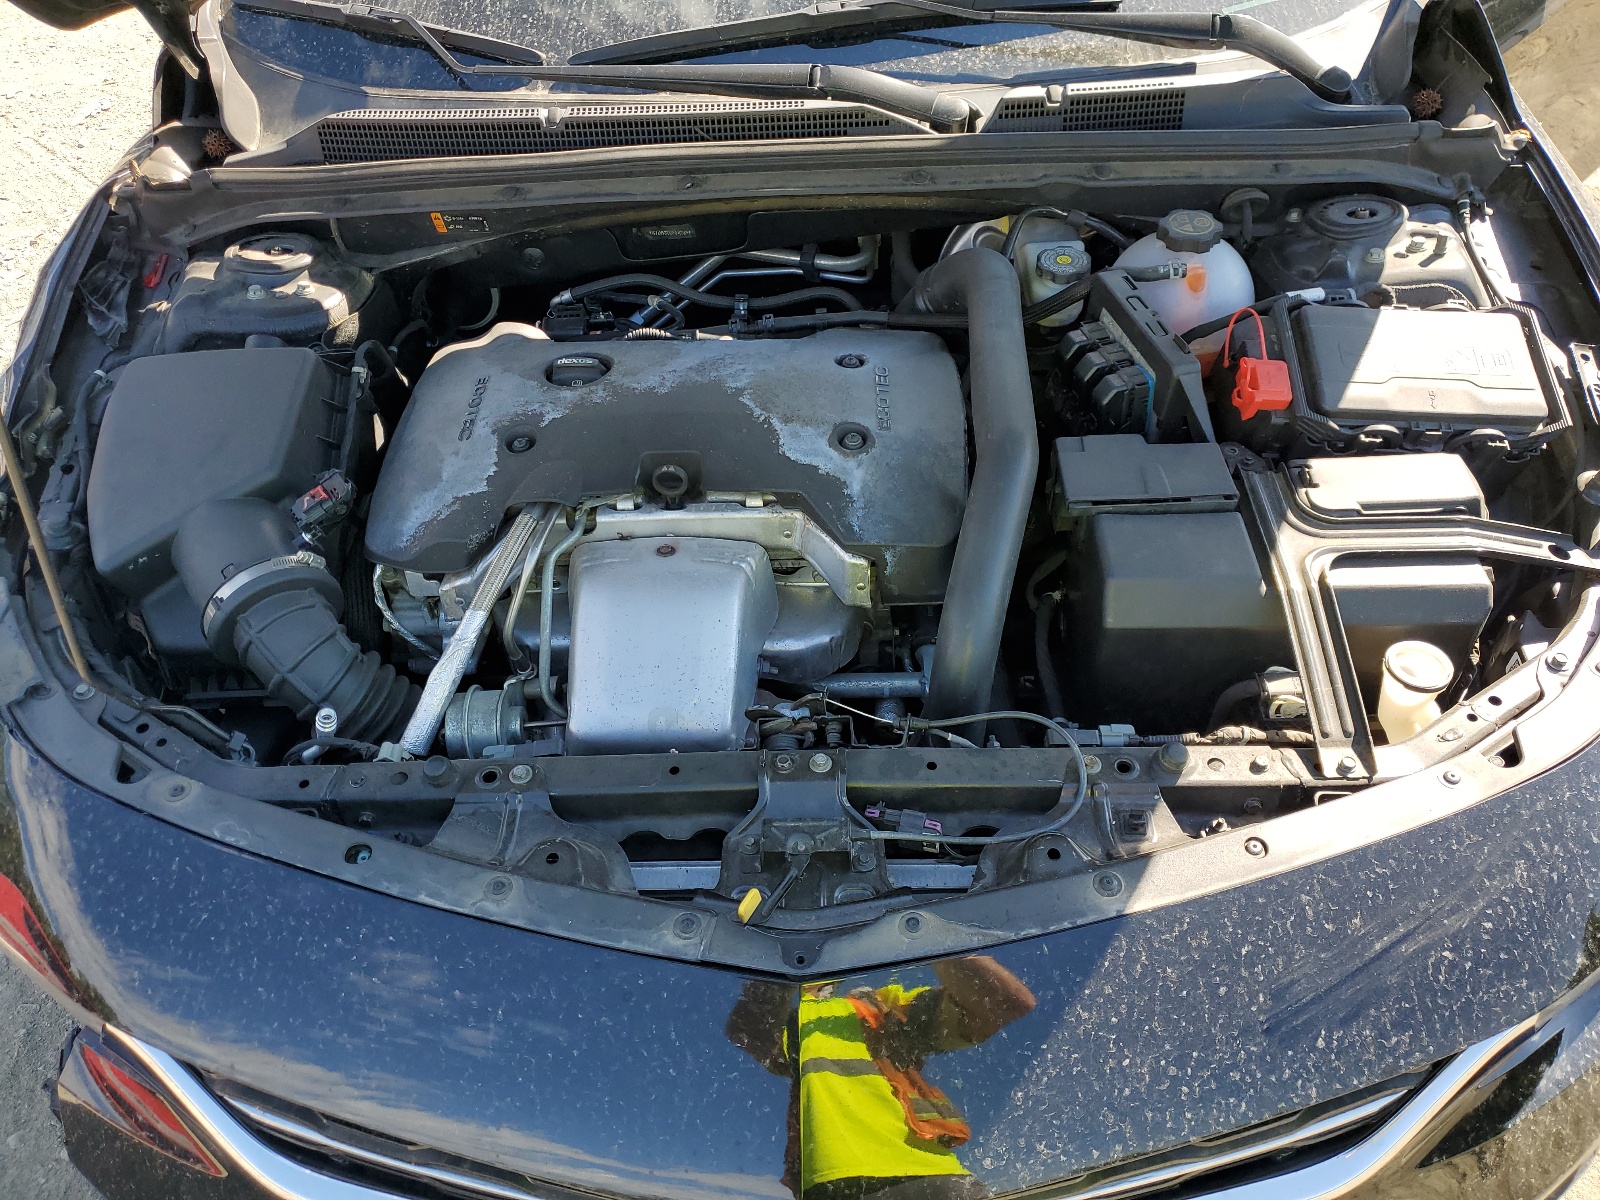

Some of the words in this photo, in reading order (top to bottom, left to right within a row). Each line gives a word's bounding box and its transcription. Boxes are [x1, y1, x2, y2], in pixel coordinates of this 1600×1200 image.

[557, 357, 593, 365] dexos
[458, 376, 490, 441] ECOTEC
[874, 366, 892, 431] ECOTEC
